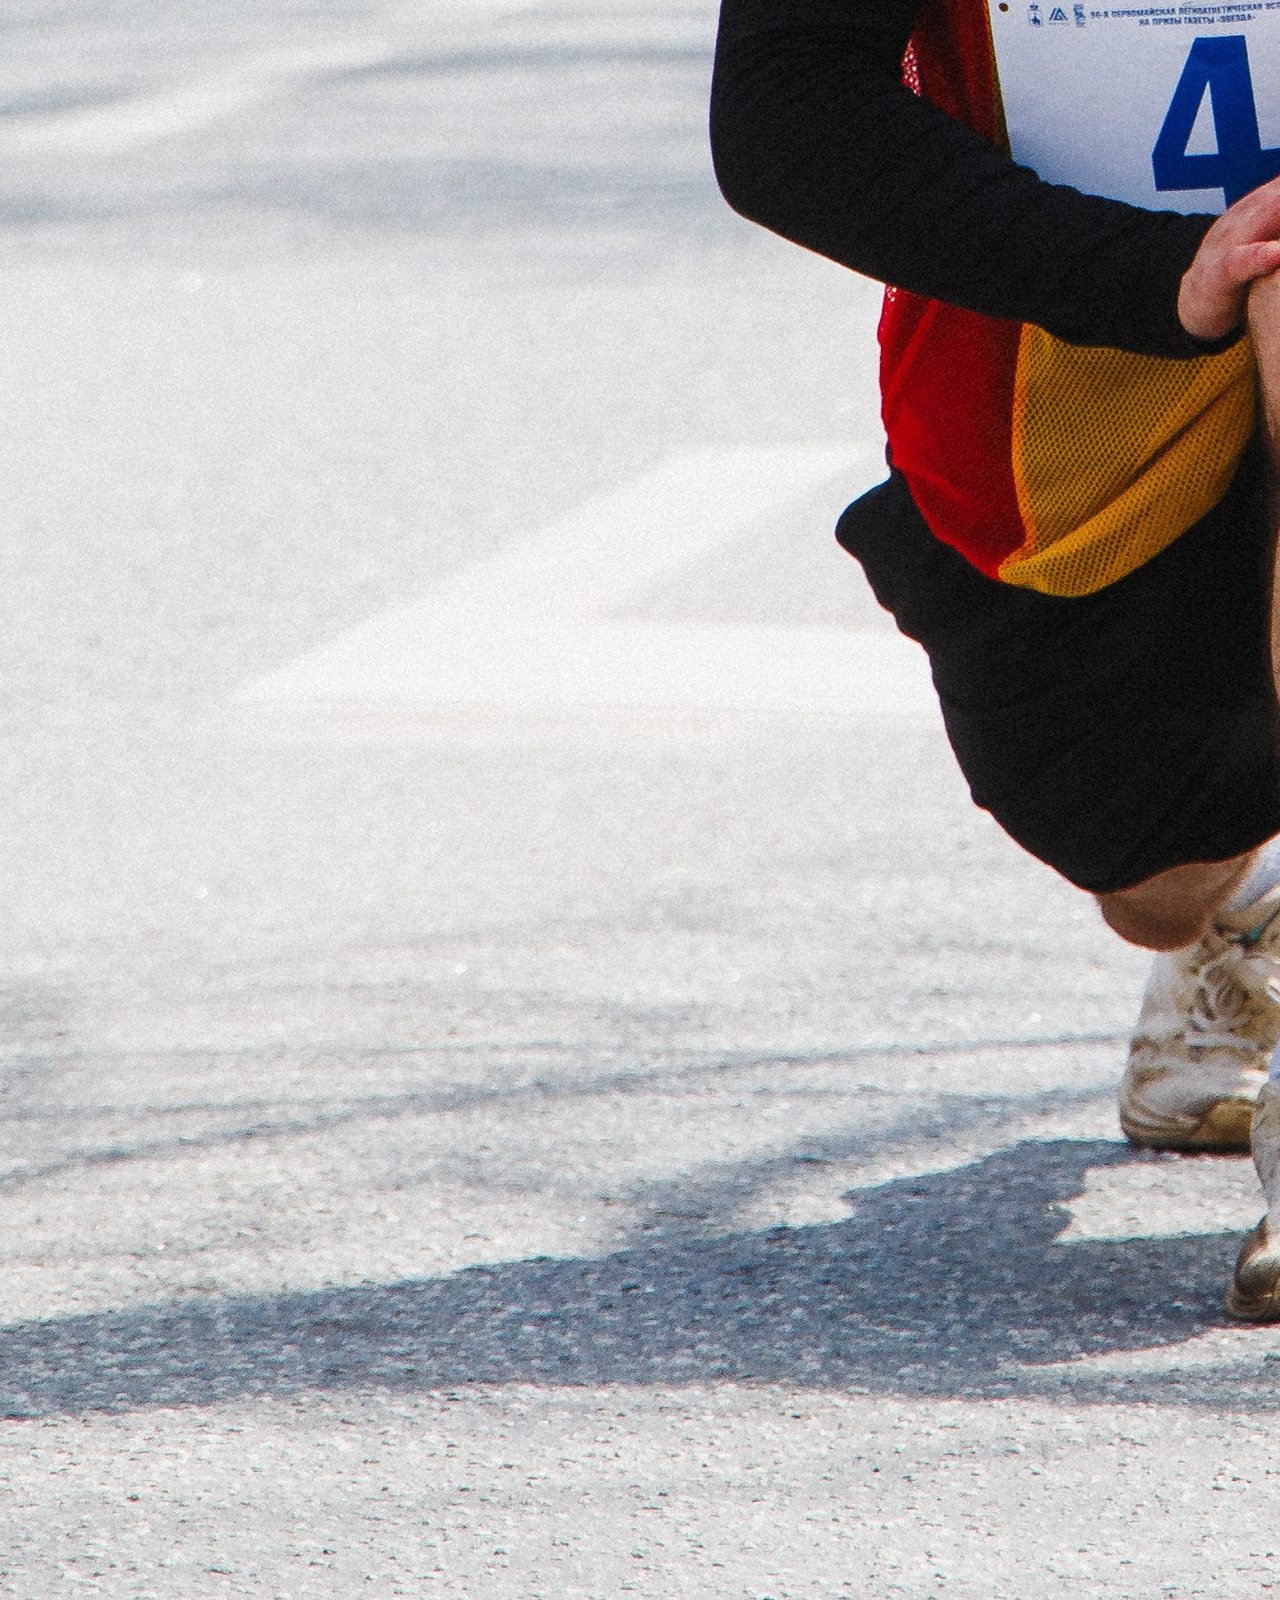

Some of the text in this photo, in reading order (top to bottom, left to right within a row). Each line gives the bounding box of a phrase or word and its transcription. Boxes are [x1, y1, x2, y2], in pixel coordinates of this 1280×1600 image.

[1111, 7, 1176, 18] ПЕРВОМАЙСКАЯ
[1138, 18, 1150, 27] НА
[1152, 17, 1182, 26] ПРИЗЫ
[1184, 16, 1215, 25] ГАЗЕТЫ
